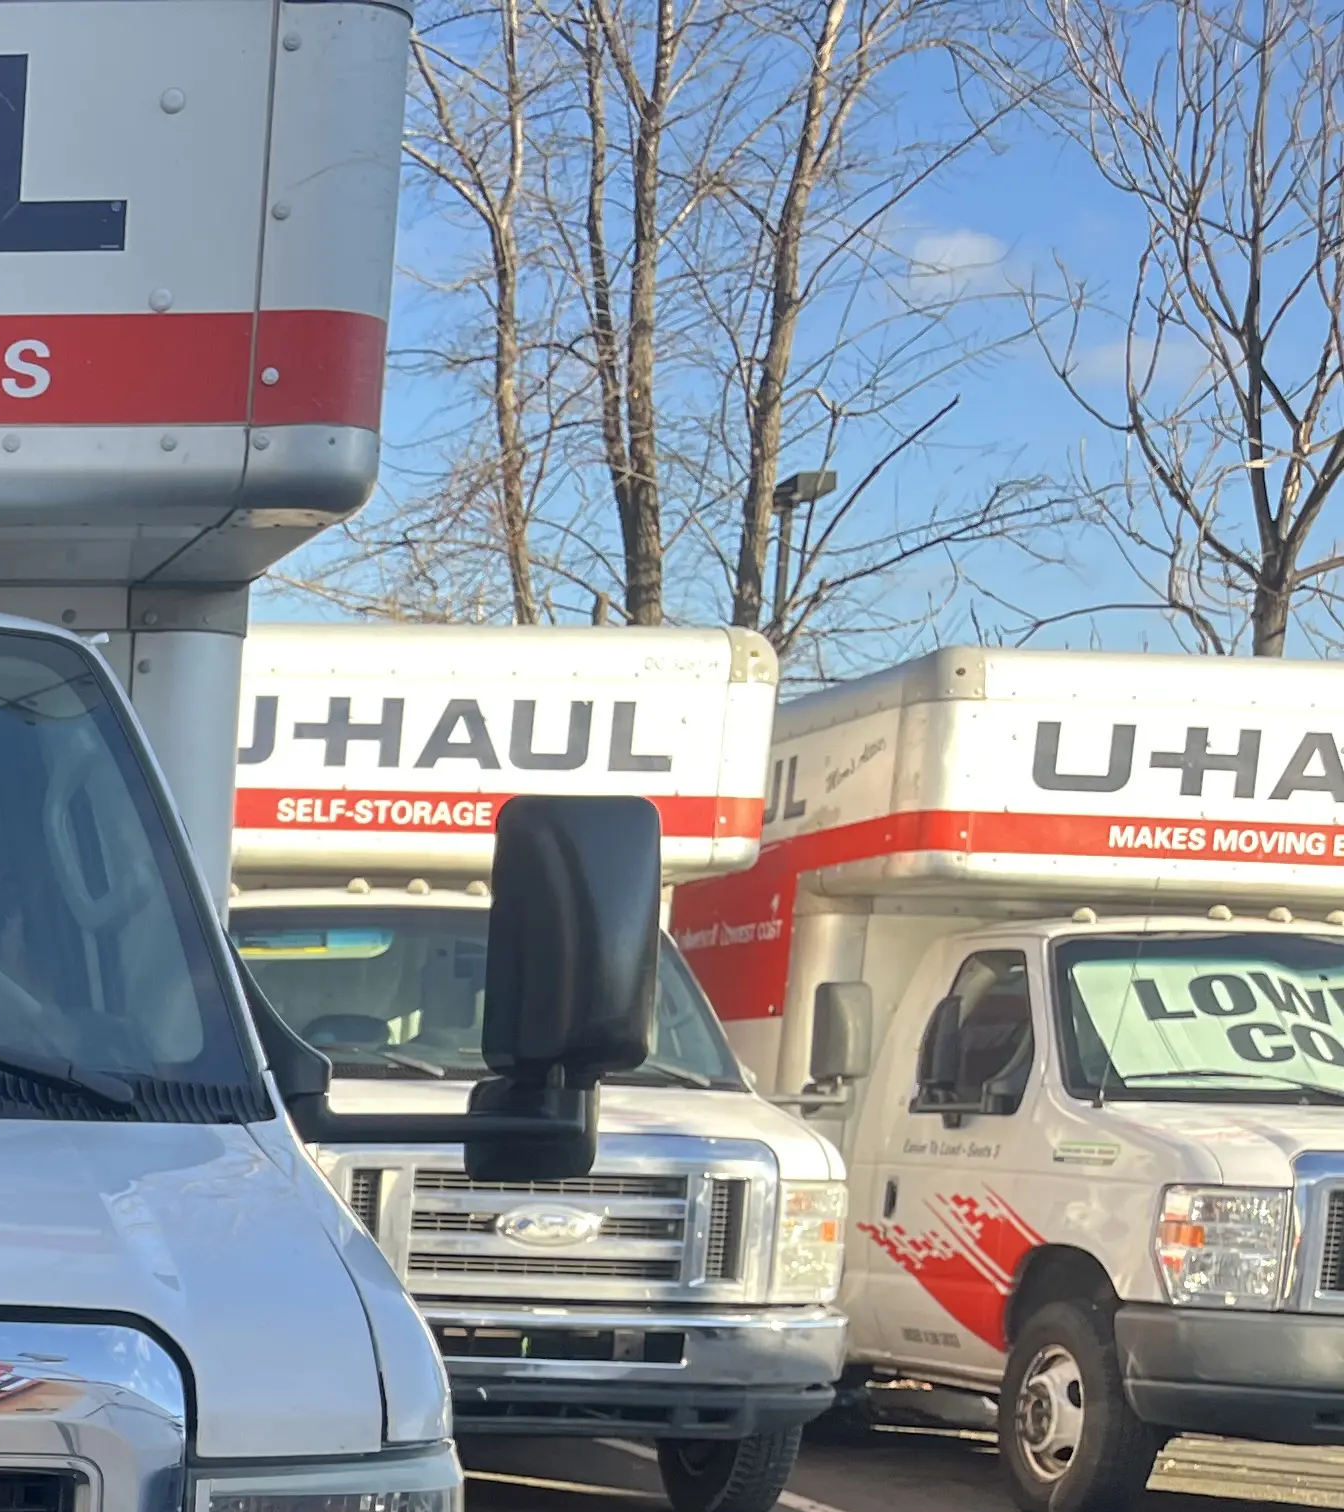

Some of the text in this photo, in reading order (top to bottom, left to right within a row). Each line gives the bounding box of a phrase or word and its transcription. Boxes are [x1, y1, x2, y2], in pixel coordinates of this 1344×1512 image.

[276, 797, 493, 826] SELF-STORAGE
[1108, 825, 1207, 852] MAKES
[1212, 828, 1327, 857] MOVING
[1132, 971, 1344, 1027] LOW
